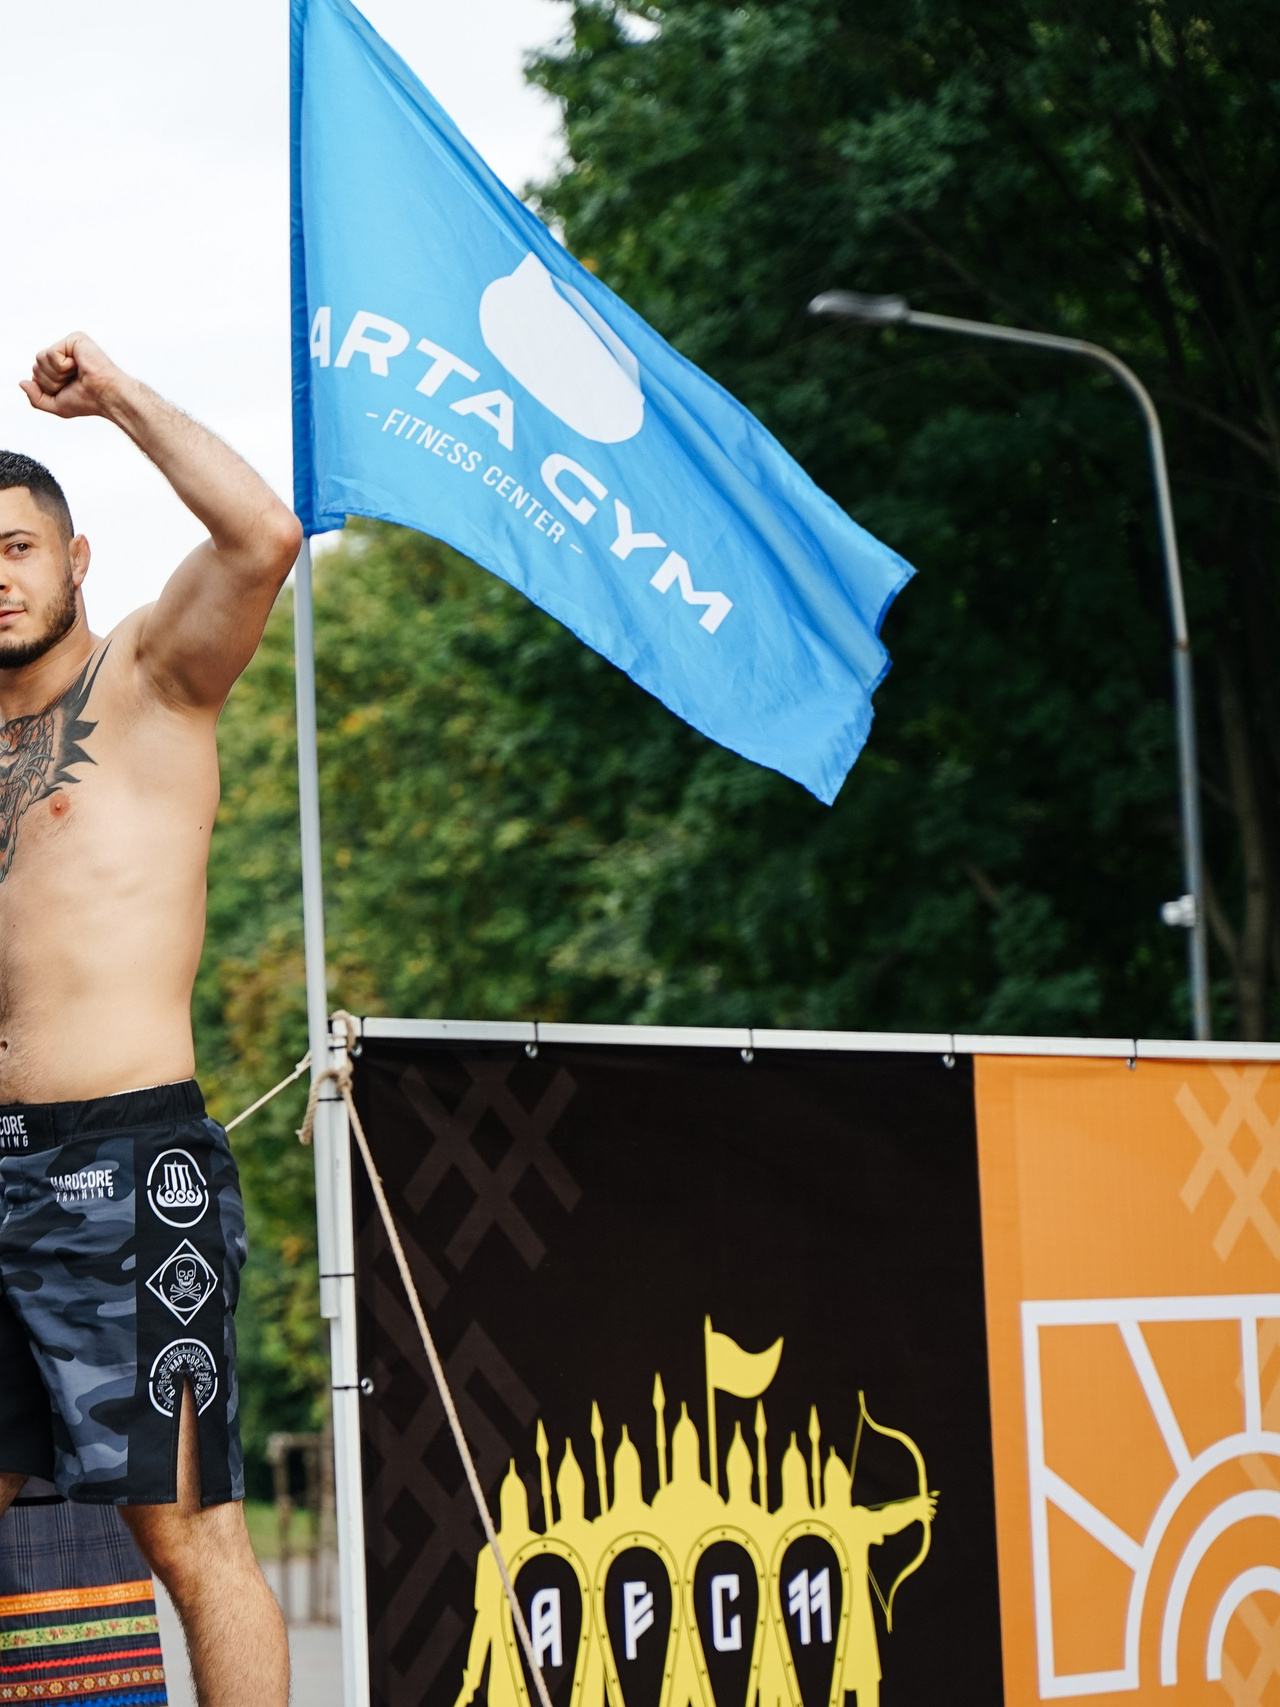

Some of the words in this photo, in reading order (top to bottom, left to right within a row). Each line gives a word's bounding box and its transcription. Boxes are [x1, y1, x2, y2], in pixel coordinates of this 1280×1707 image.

[381, 408, 483, 473] FITNESS
[482, 465, 566, 545] CENTER
[540, 453, 733, 635] GYM
[50, 1169, 114, 1192] HARDCORE
[55, 1186, 114, 1203] TRAINING
[530, 1588, 563, 1668] A
[623, 1580, 655, 1661] F
[711, 1573, 742, 1652] C
